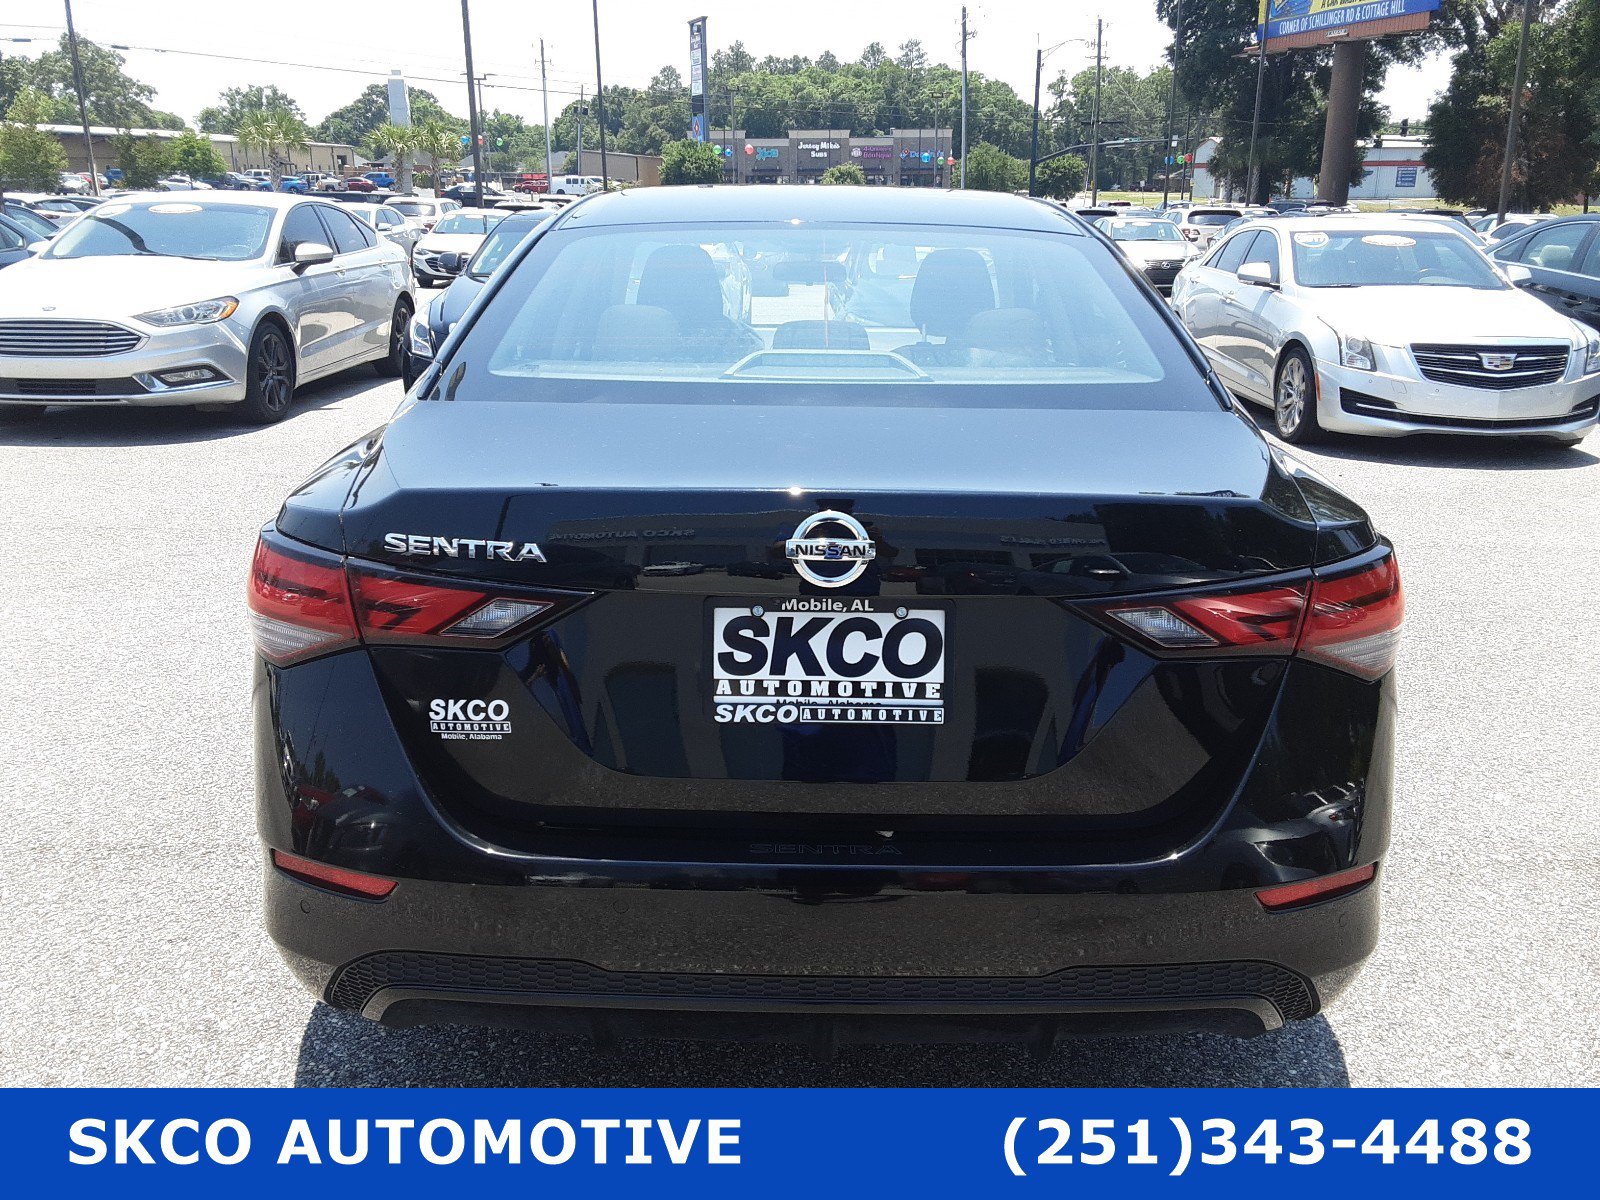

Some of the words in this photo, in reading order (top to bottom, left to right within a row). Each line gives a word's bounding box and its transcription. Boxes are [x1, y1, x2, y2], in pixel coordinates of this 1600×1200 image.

[1279, 18, 1300, 34] CORNER
[1300, 16, 1309, 31] OF
[1309, 9, 1345, 29] SCHILLINGER
[1345, 8, 1355, 23] RD
[1355, 6, 1361, 21] &
[1361, 1, 1390, 20] COTTAGE
[1390, 0, 1406, 15] HILL
[798, 141, 820, 151] Jersey
[384, 532, 548, 563] SENTRA
[795, 544, 866, 556] NISSAN
[781, 598, 848, 613] Mobile,
[850, 600, 874, 612] AL
[717, 615, 944, 680] SKCO
[716, 679, 942, 699] AUTOMOTIVE
[428, 698, 510, 721] SKCO
[714, 704, 799, 723] SKCO
[802, 708, 942, 722] AUTOMOTIVE
[432, 722, 510, 731] AUTOMOTIVE
[441, 732, 468, 740] Mobile,
[750, 843, 903, 855] SENTRA
